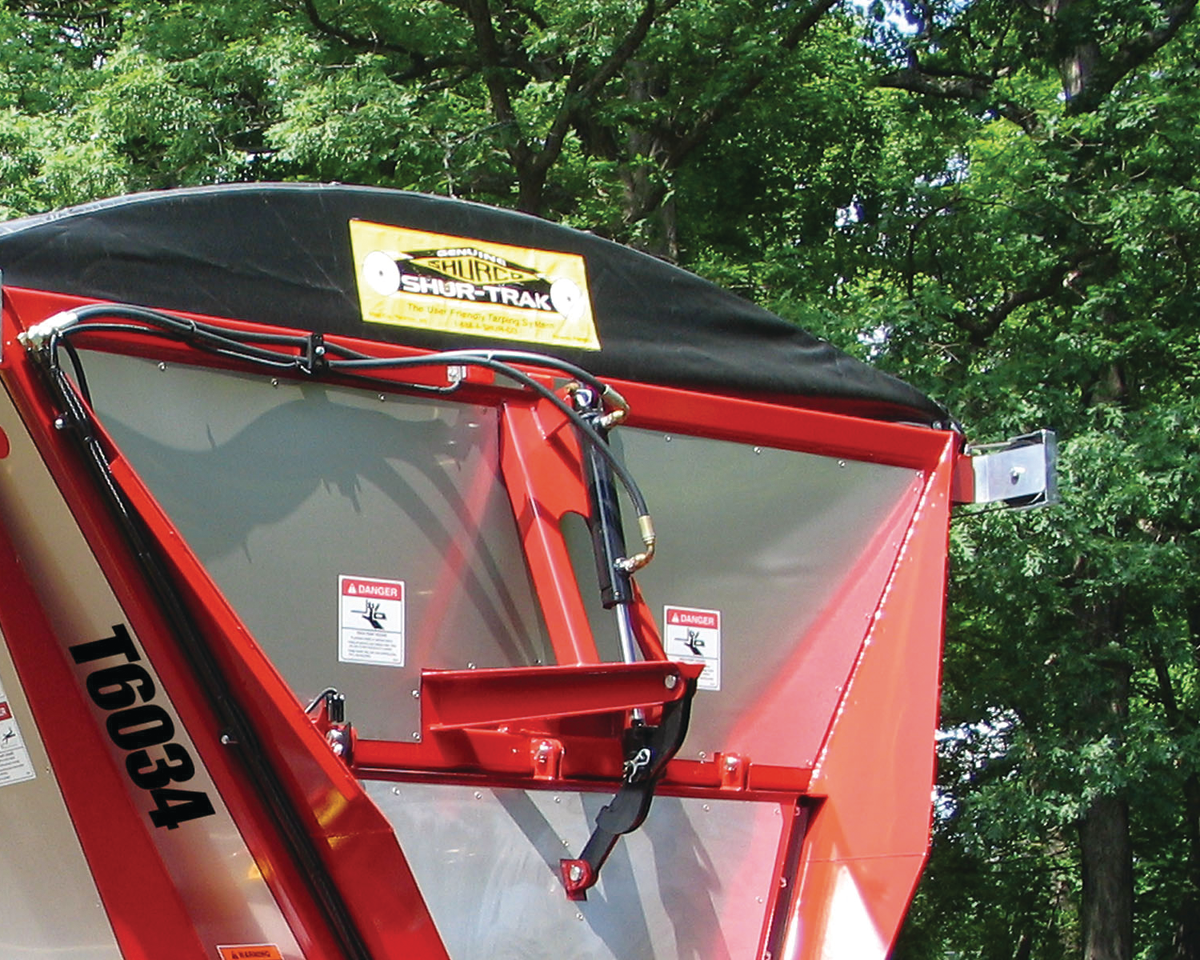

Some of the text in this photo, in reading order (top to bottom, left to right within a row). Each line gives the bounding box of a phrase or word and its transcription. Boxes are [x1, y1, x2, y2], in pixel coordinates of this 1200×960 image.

[401, 273, 552, 311] SHUR-TRAK
[358, 584, 398, 598] DANGER
[680, 613, 715, 627] DANGER
[68, 623, 216, 831] T6034
